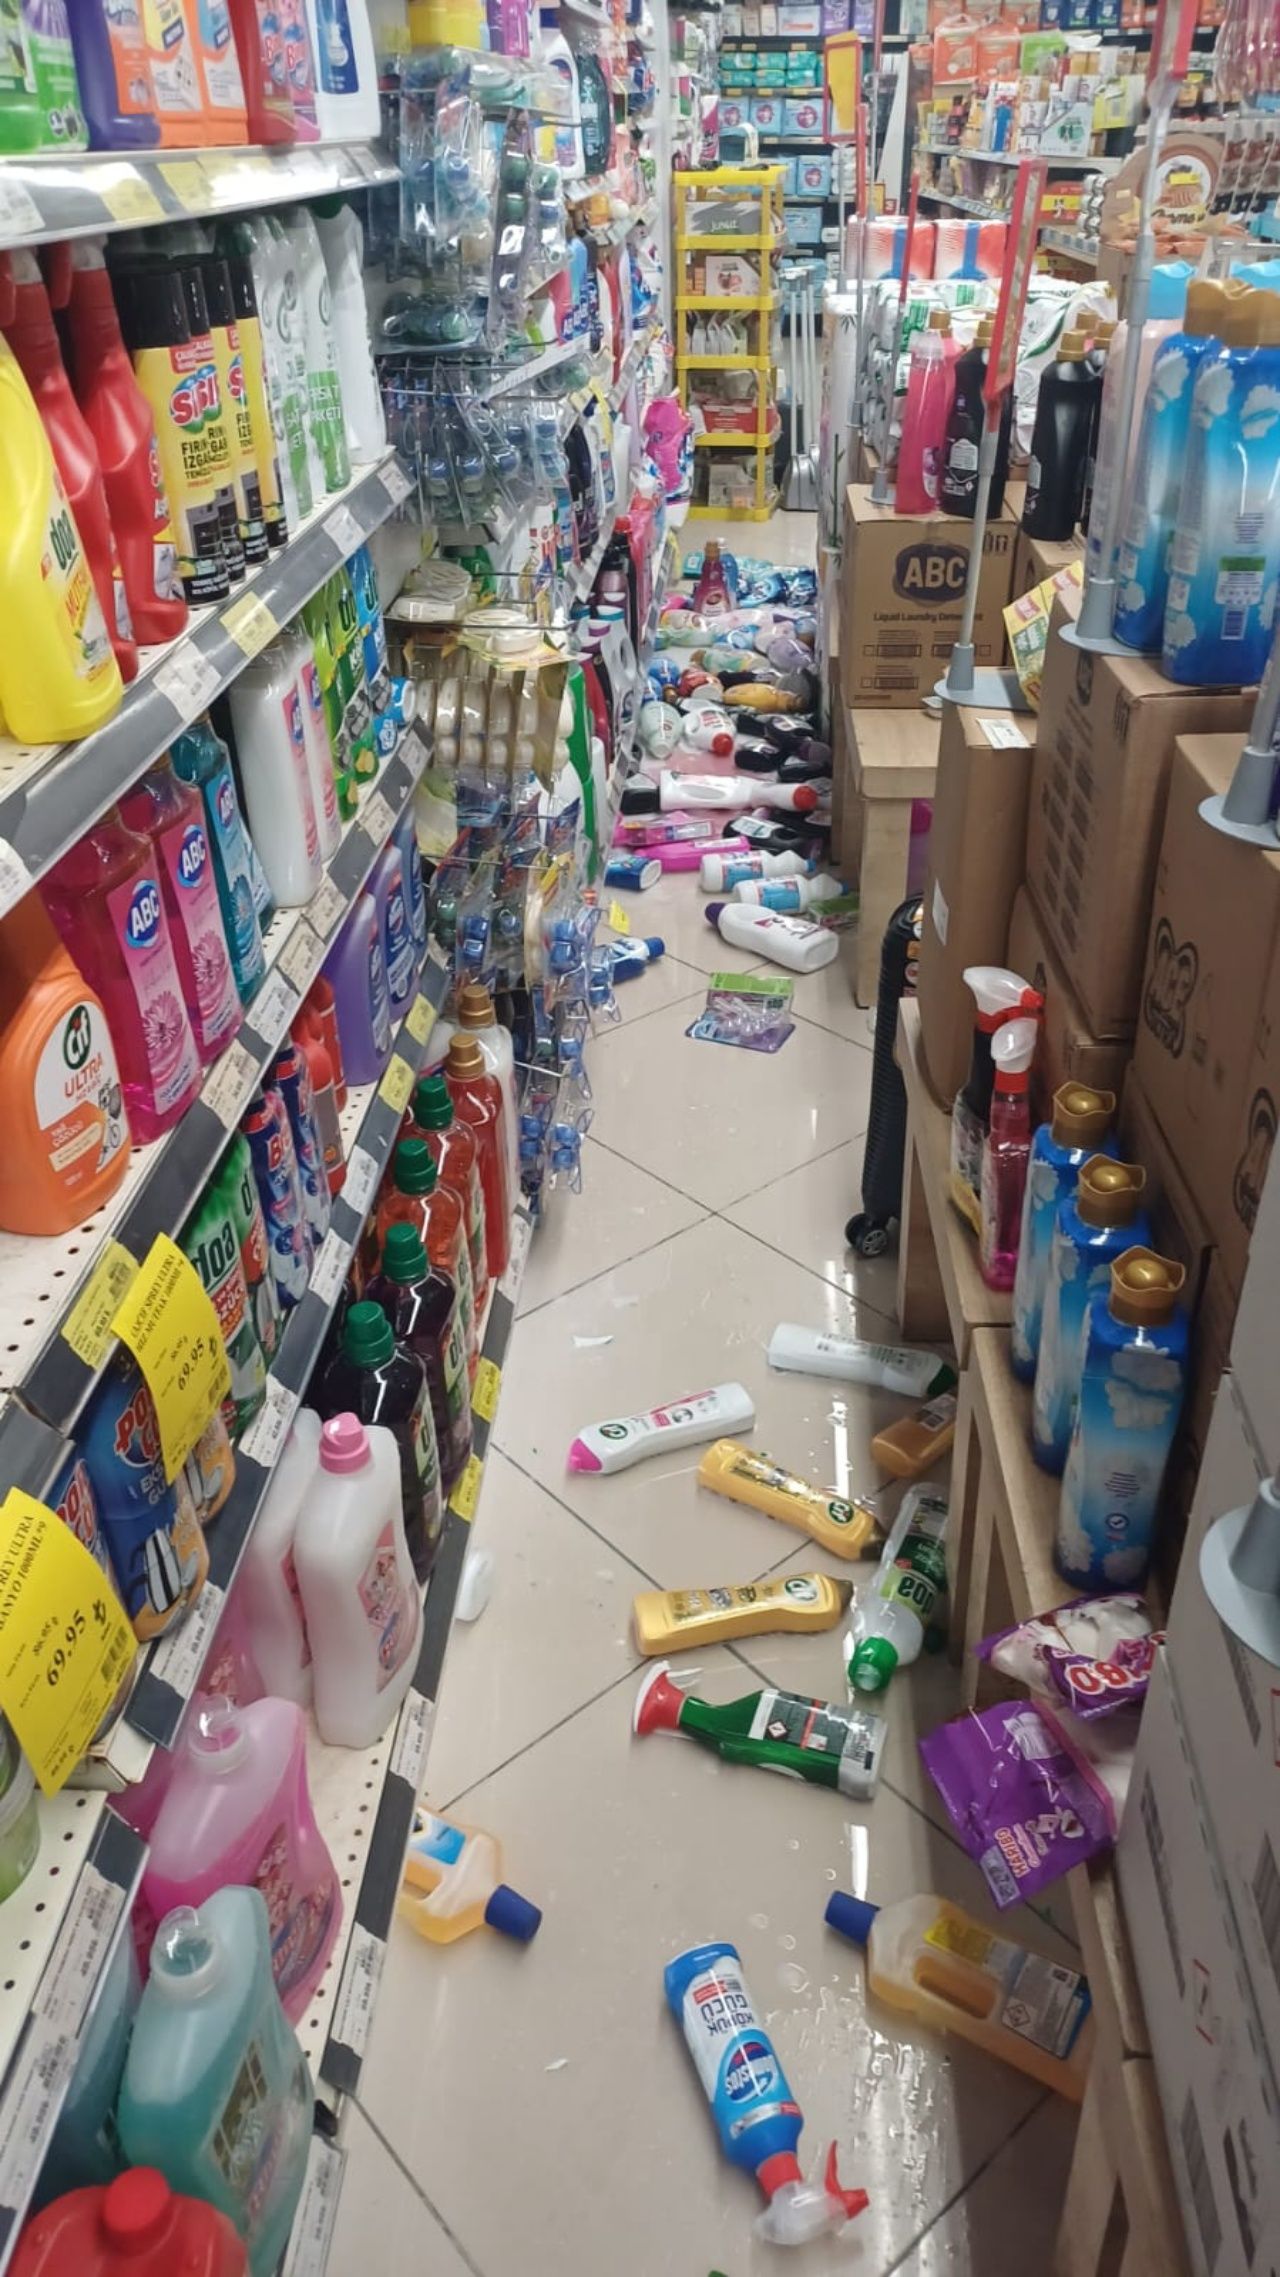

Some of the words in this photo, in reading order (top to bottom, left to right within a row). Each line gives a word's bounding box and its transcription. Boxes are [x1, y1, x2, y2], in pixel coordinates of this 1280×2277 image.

[902, 555, 966, 589] ABC
[181, 836, 206, 878] ABC
[131, 889, 160, 938] ABC
[65, 1055, 103, 1098] ULTRA
[177, 1338, 204, 1391] 69.95
[47, 1611, 86, 1687] 69.95
[701, 1994, 748, 2024] GÜCÜ
[708, 2011, 755, 2037] KÖPÜK
